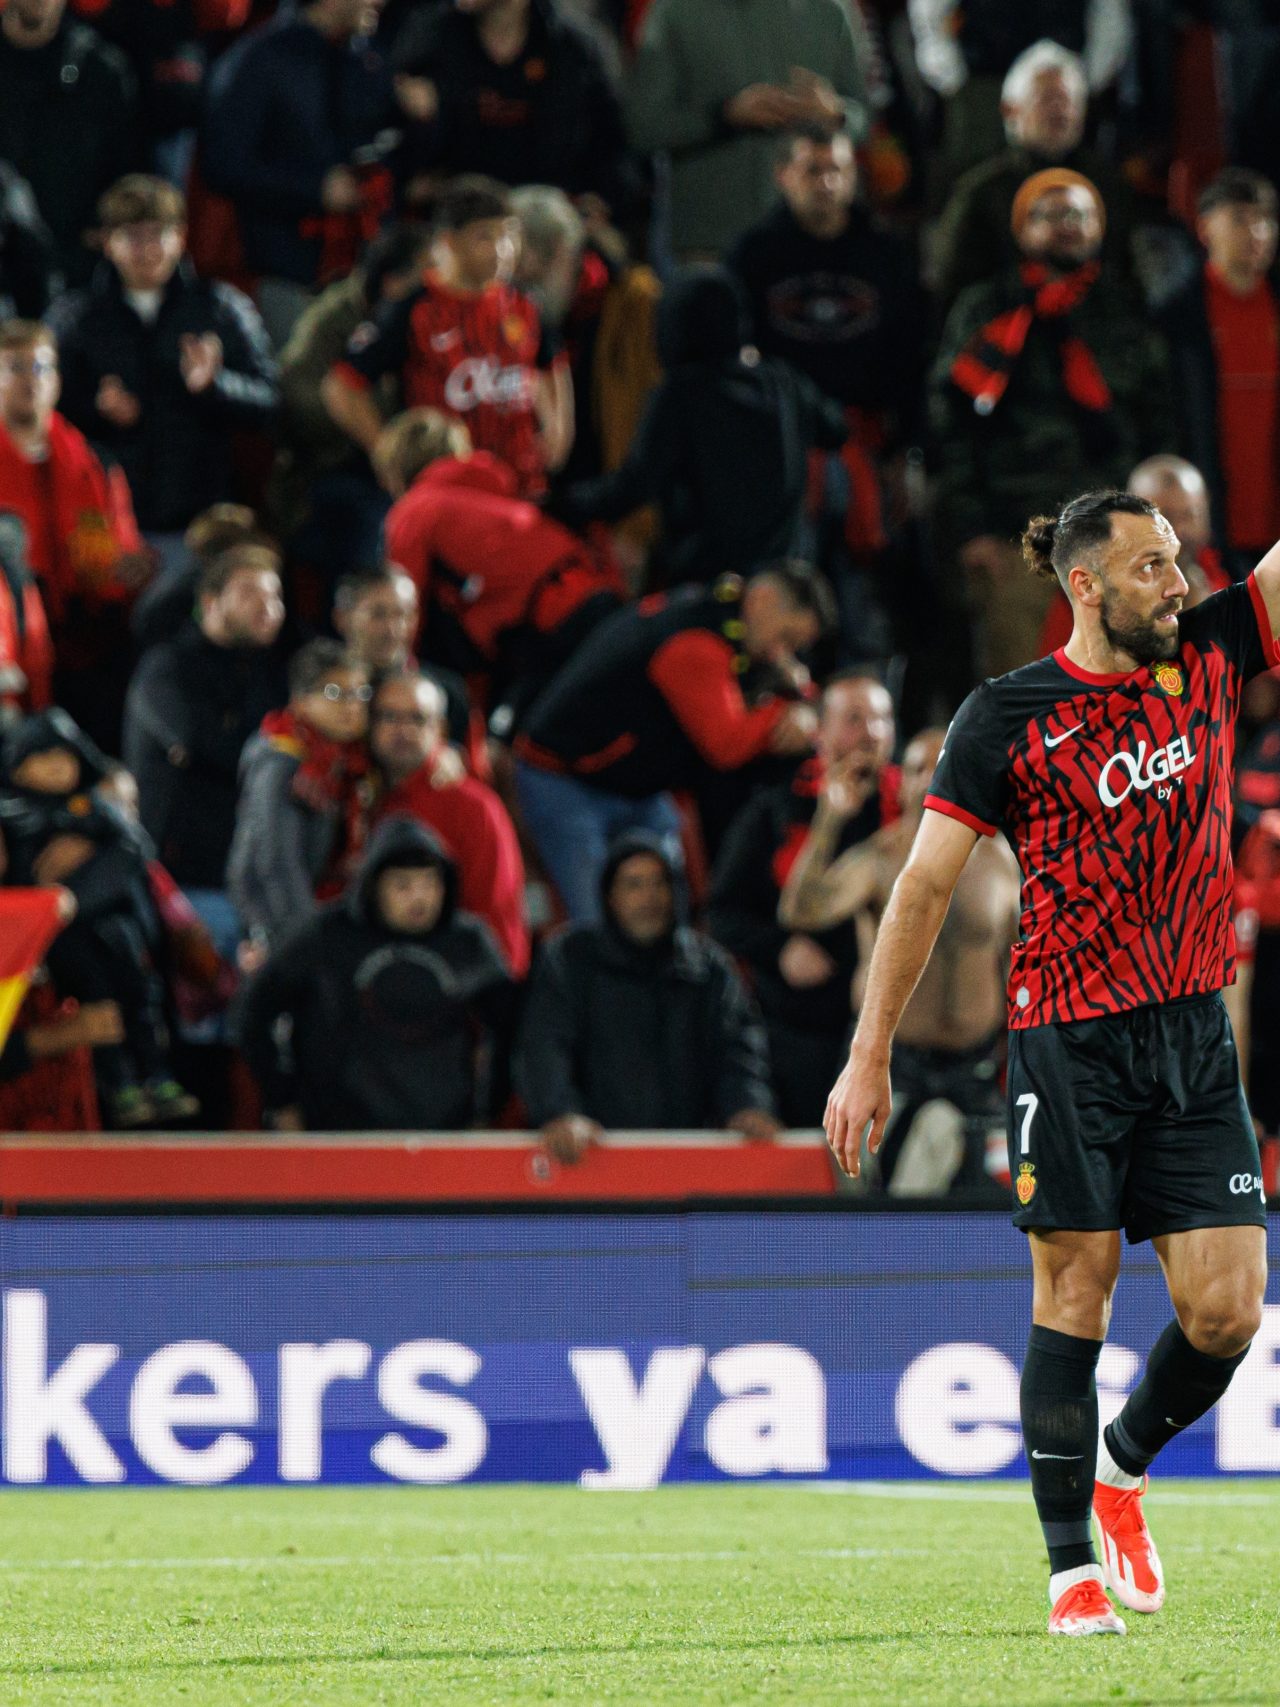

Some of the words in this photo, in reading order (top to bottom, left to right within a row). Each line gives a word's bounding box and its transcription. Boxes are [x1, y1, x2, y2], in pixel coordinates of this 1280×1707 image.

[1015, 1092, 1039, 1154] 7
[3, 1287, 489, 1484] kers
[567, 1342, 831, 1491] ya
[894, 1341, 1141, 1476] e
